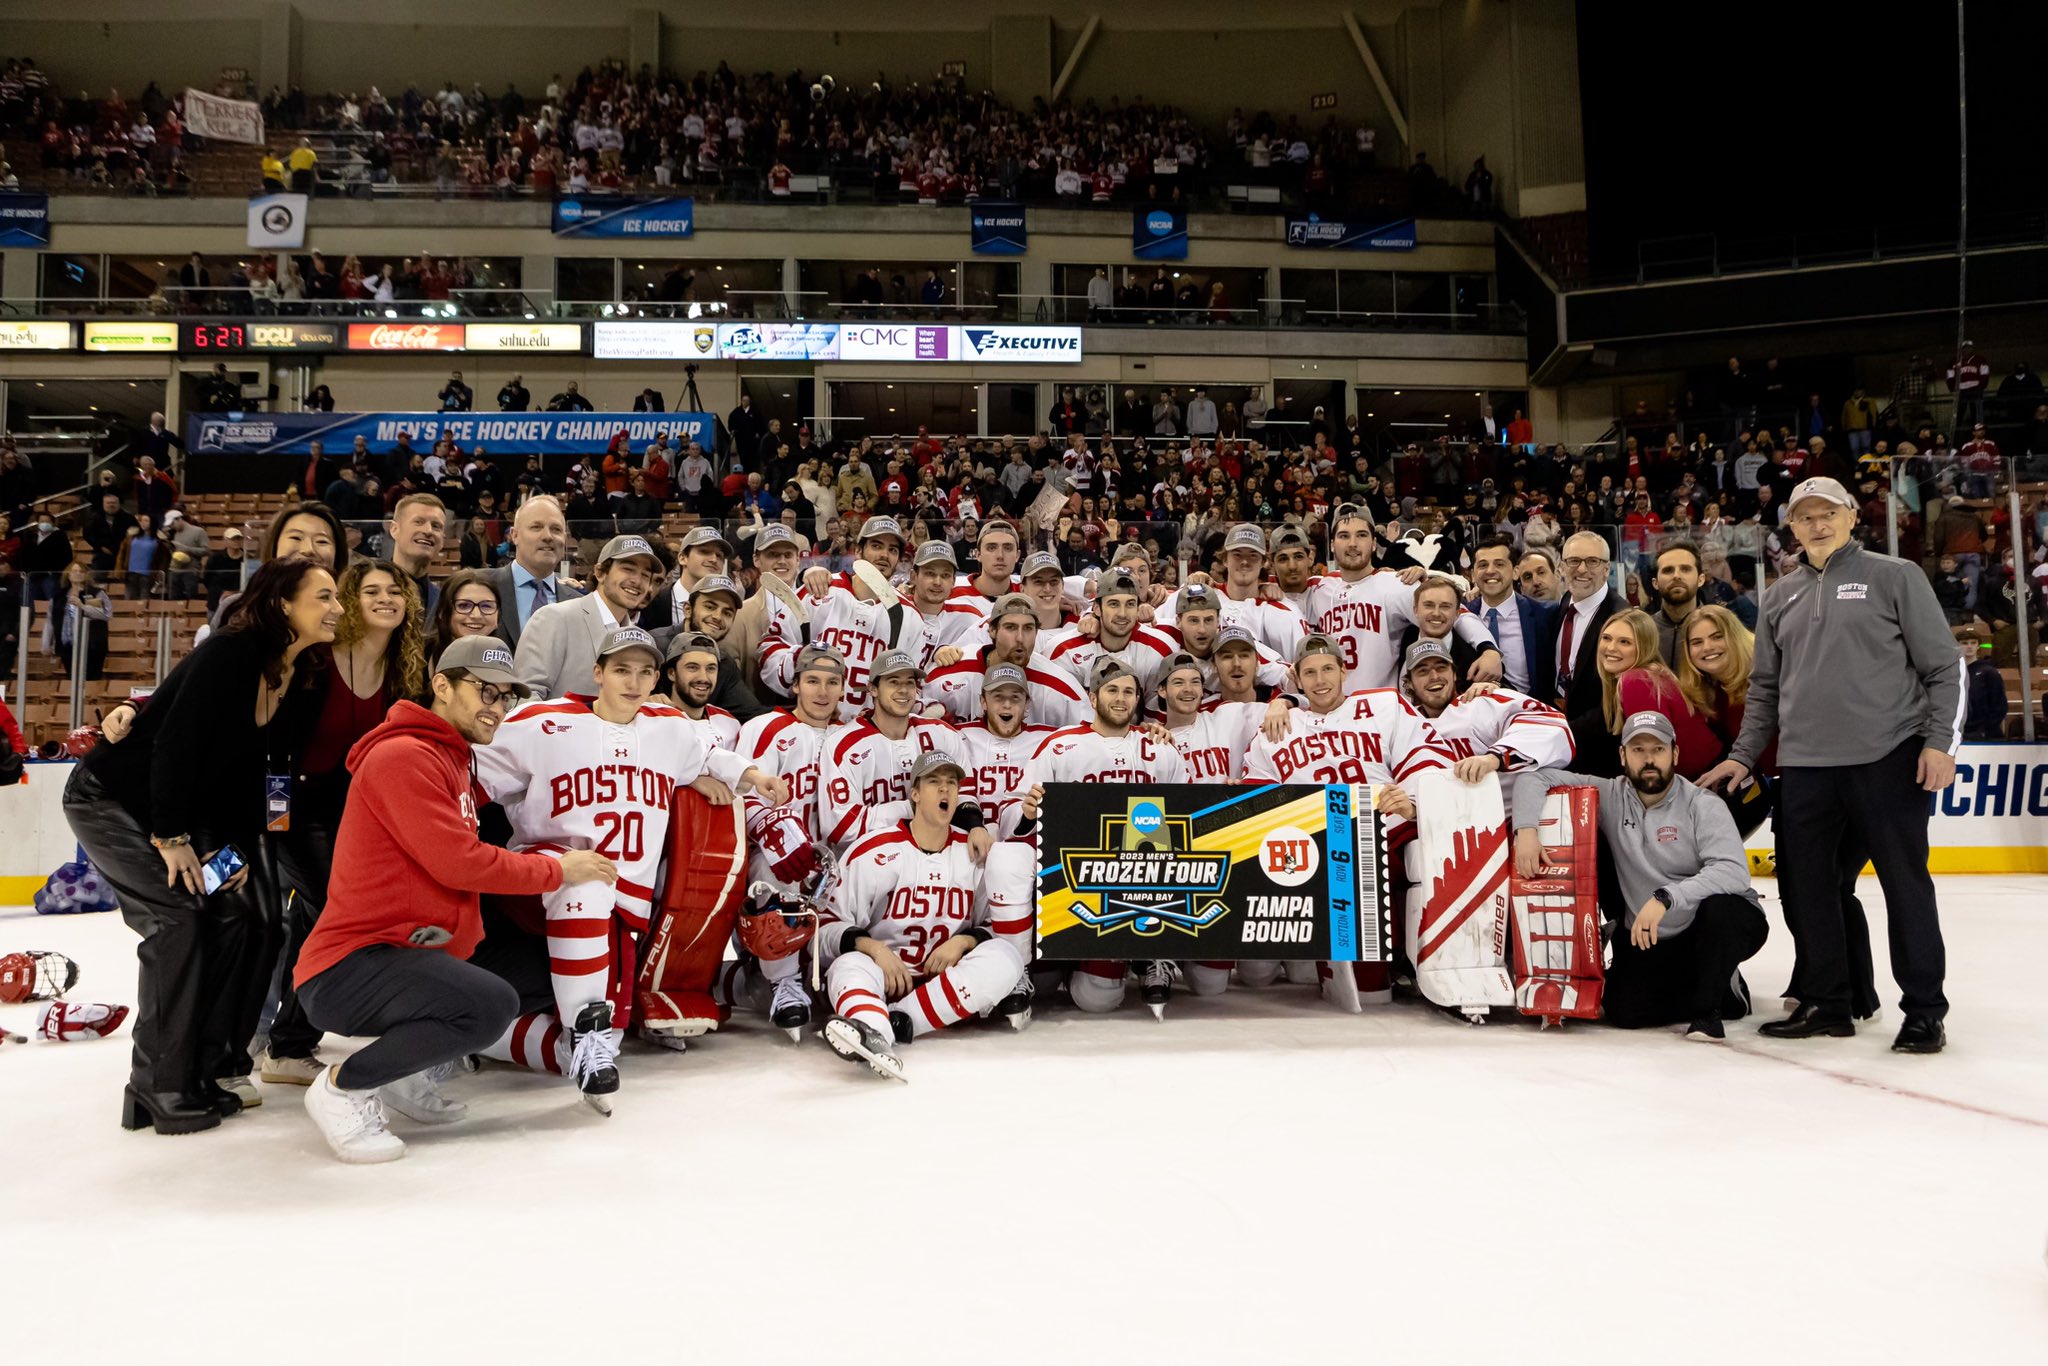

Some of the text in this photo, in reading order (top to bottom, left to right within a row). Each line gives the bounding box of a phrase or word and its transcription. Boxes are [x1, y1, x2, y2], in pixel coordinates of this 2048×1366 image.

[623, 219, 688, 232] ICE HOCKEY
[983, 217, 995, 227] ICE
[996, 217, 1023, 227] HOCKEY
[1149, 220, 1173, 230] NCAA
[1320, 226, 1346, 235] HOCKEY
[254, 327, 293, 343] DCU
[499, 332, 550, 348] snhu.edu
[860, 328, 908, 346] CMC
[227, 426, 278, 437] ICE HOCKEY
[377, 421, 702, 441] MEN'S ICE HOCKEY CHAMPIONSHIP
[1836, 583, 1867, 592] BOSTON
[818, 628, 887, 662] OSTO
[1336, 635, 1359, 671] 3
[1352, 698, 1375, 721] A
[917, 731, 935, 755] A
[1140, 737, 1156, 762] C
[1183, 747, 1230, 779] TON
[1271, 731, 1383, 784] BOSTON
[550, 764, 675, 819] BOSTON
[827, 776, 850, 810] 18
[756, 809, 802, 835] BAU
[1134, 816, 1161, 825] NCAA
[593, 811, 645, 863] 20
[1266, 839, 1310, 873] BU
[1078, 861, 1218, 884] FROZEN FOUR
[1329, 790, 1352, 948] SECTION 4 ROW 6 SEAT 23
[1121, 893, 1174, 902] TAMPA BAY
[1246, 896, 1314, 918] TAMPA
[1241, 921, 1314, 943] BOUND
[639, 913, 674, 983] TRUE
[899, 924, 950, 971] 32
